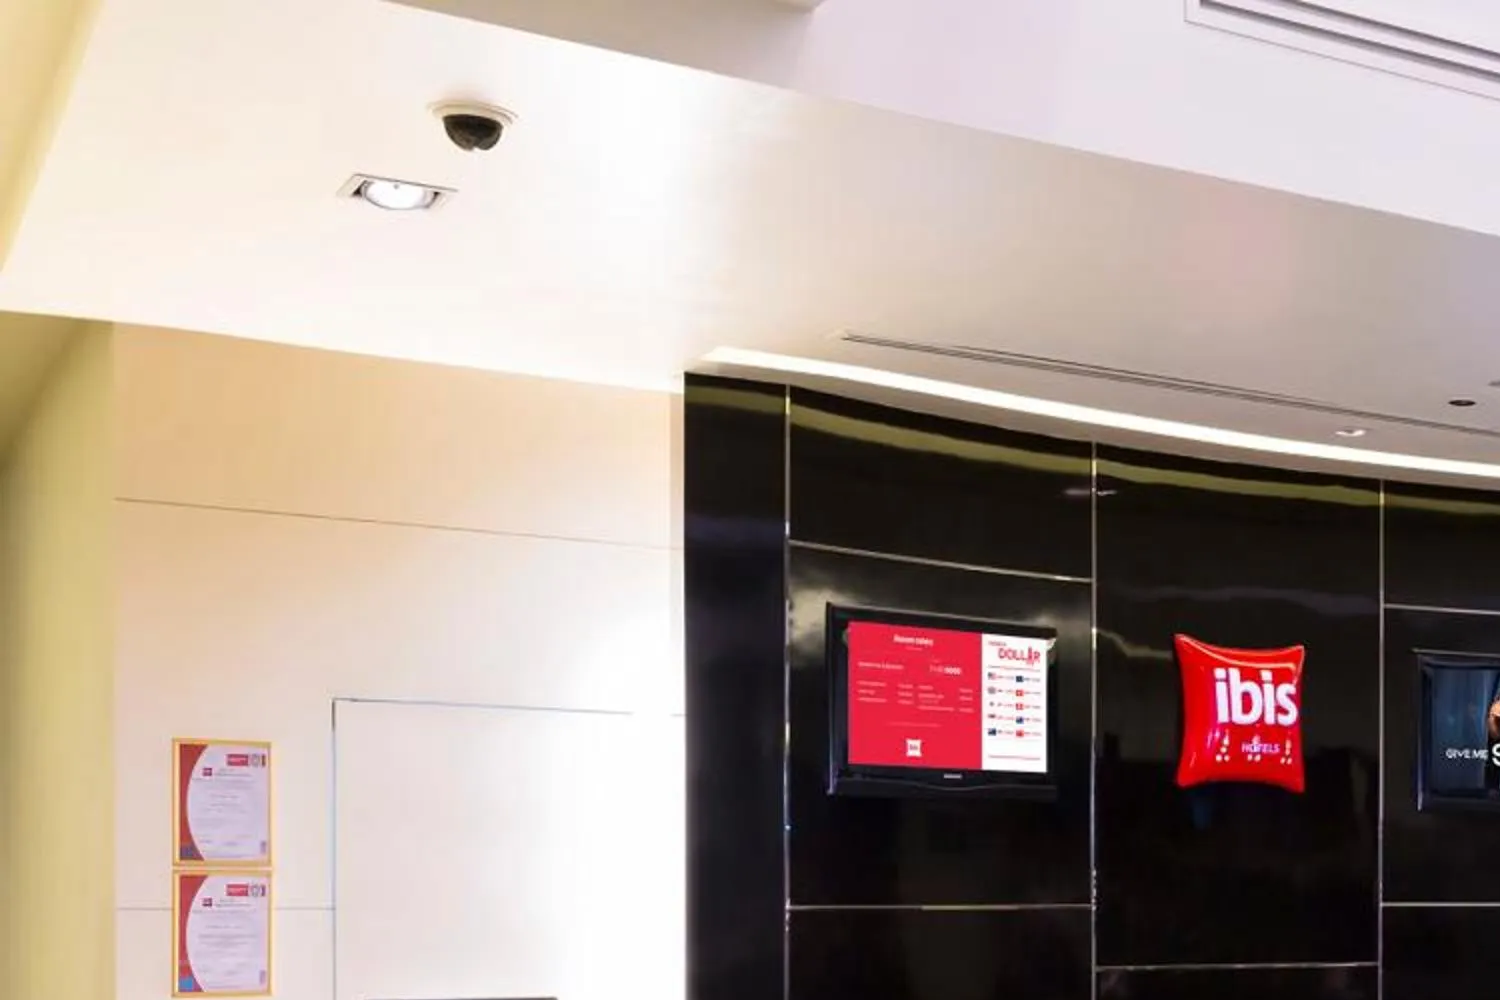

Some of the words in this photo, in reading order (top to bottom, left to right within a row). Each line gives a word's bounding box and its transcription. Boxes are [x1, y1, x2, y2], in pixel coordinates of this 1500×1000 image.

[1213, 667, 1298, 726] ibis
[1445, 748, 1470, 759] GIVE
[1472, 749, 1488, 760] ME
